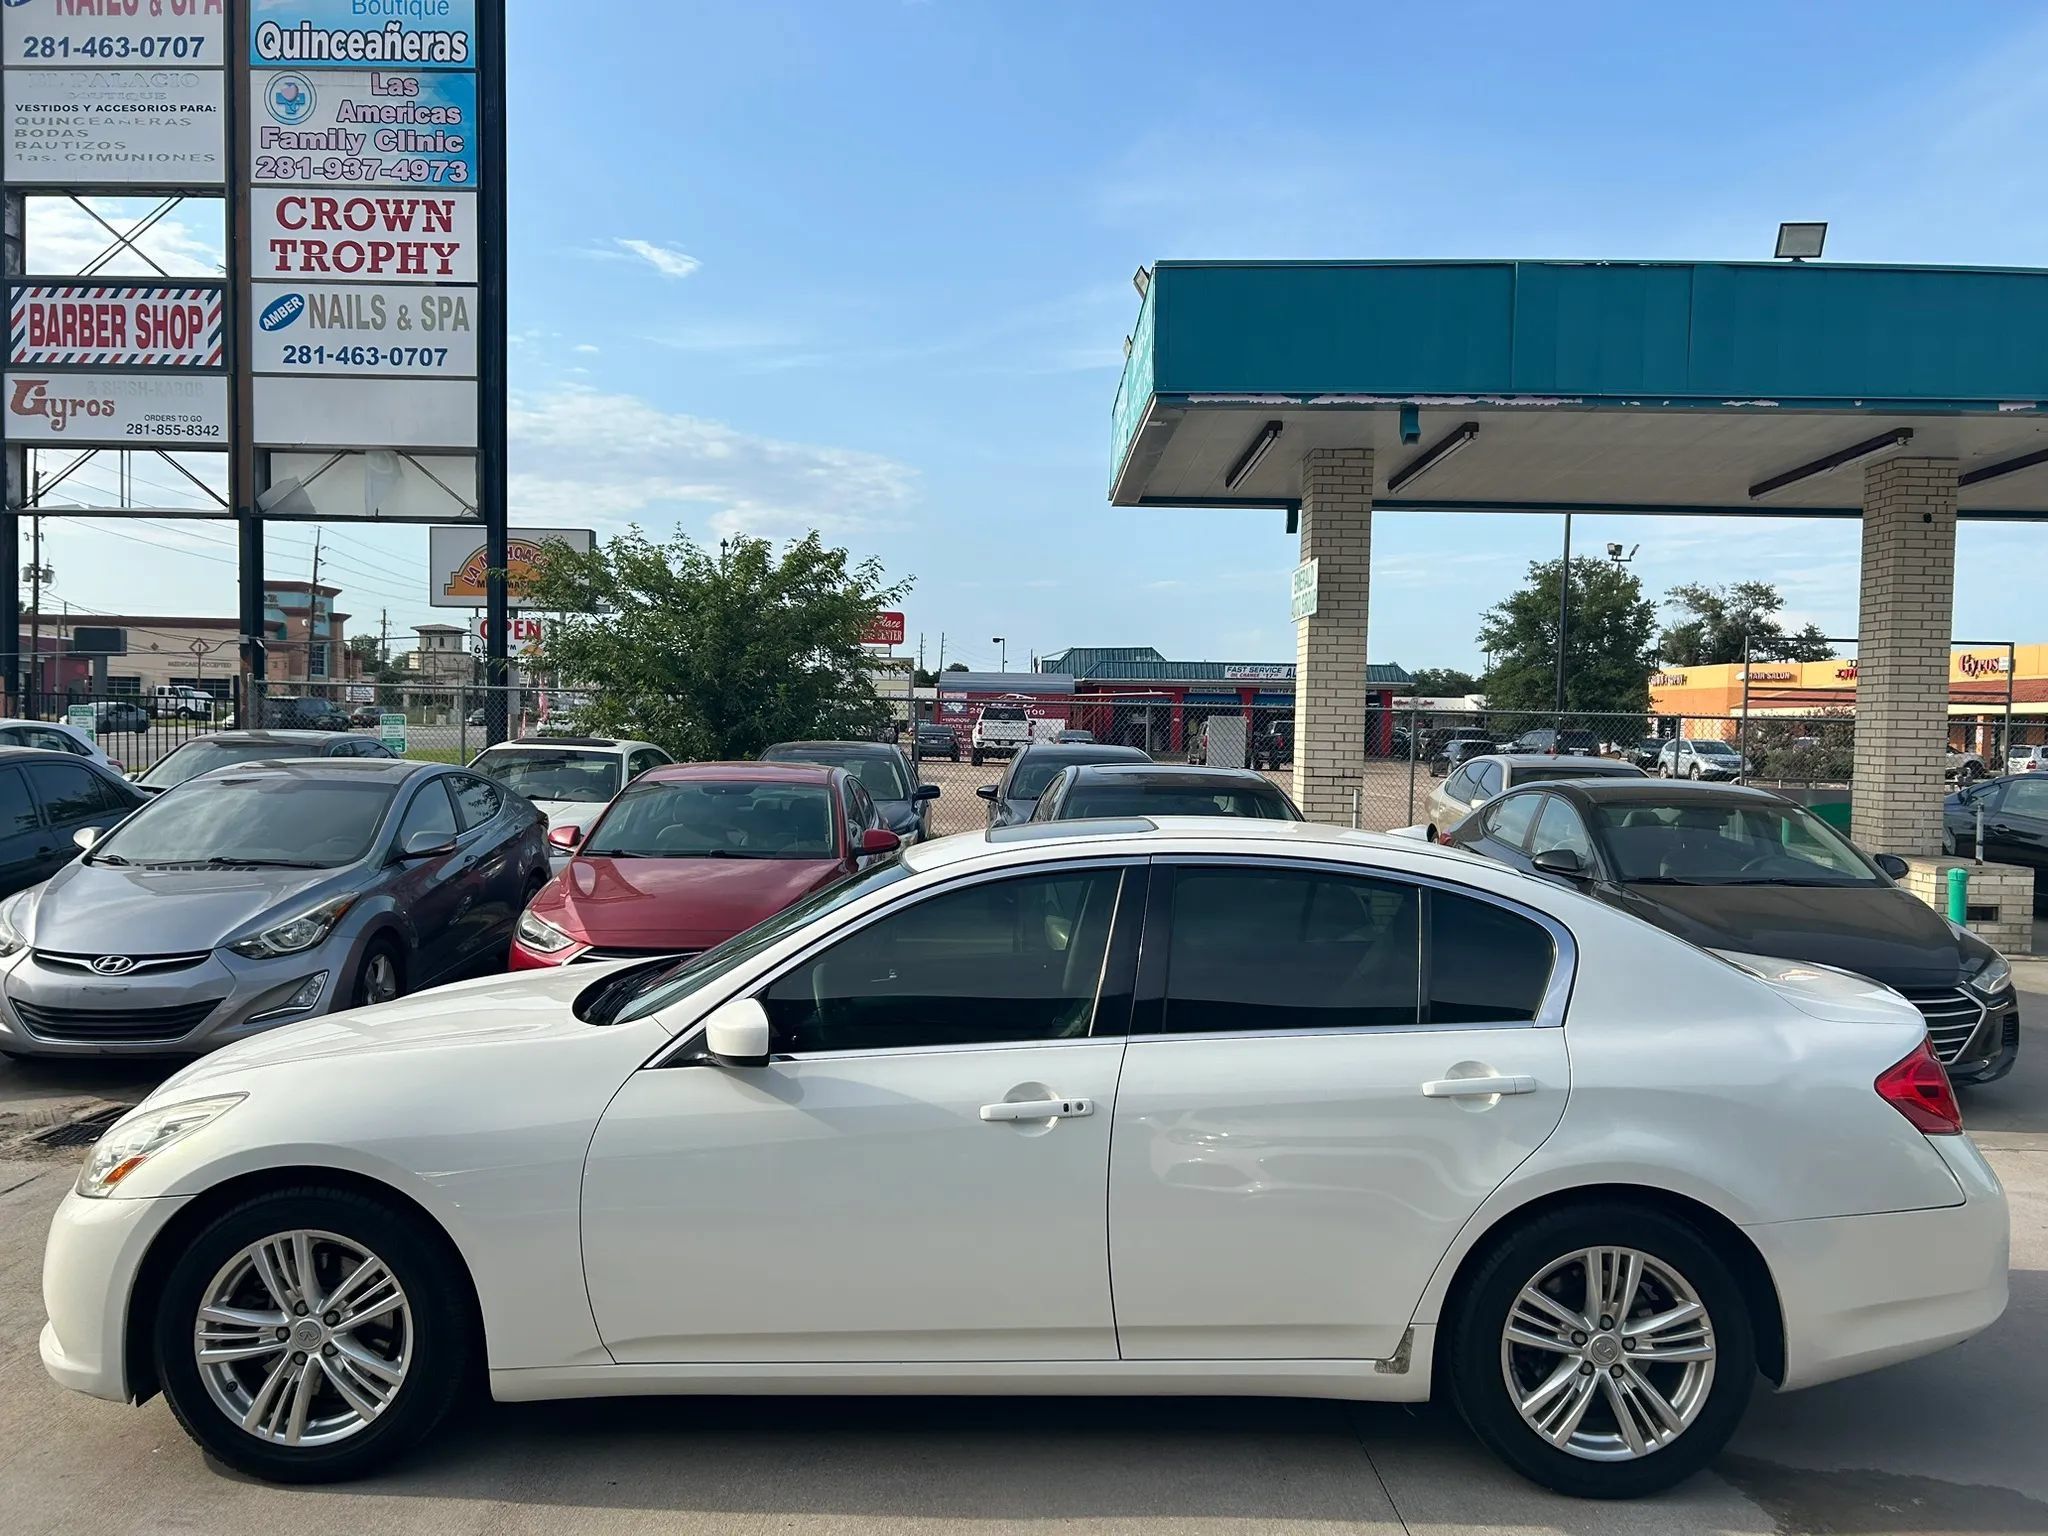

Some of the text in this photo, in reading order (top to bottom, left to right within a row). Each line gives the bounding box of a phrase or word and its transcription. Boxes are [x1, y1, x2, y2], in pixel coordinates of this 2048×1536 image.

[23, 36, 205, 58] 281-463-0707
[256, 20, 469, 62] Quinceañeras
[371, 72, 419, 97] Las
[15, 104, 217, 113] VESTIDOS Y ACCESORIOS PARA:
[336, 100, 461, 124] Americas
[14, 129, 89, 138] BODAS
[261, 126, 465, 156] Family Clinic
[15, 141, 126, 150] BAUTIZOS
[15, 153, 216, 163] 1as. COMUNIONES
[256, 156, 469, 183] 281-937-4973
[276, 196, 456, 233] CROWN
[269, 239, 460, 275] TROPHY
[261, 294, 304, 330] AMBER
[308, 293, 470, 332] NAILS & SPA
[29, 303, 204, 349] BARBER SHOP
[282, 345, 448, 367] 281-463-0707
[10, 379, 116, 432] Gyros
[126, 423, 220, 436] 281-855-8342
[144, 414, 176, 422] ORDERS
[461, 565, 482, 586] LA
[1227, 666, 1248, 674] FAST
[1249, 666, 1282, 674] SERVICE
[1749, 671, 1790, 680] HAIR SALON
